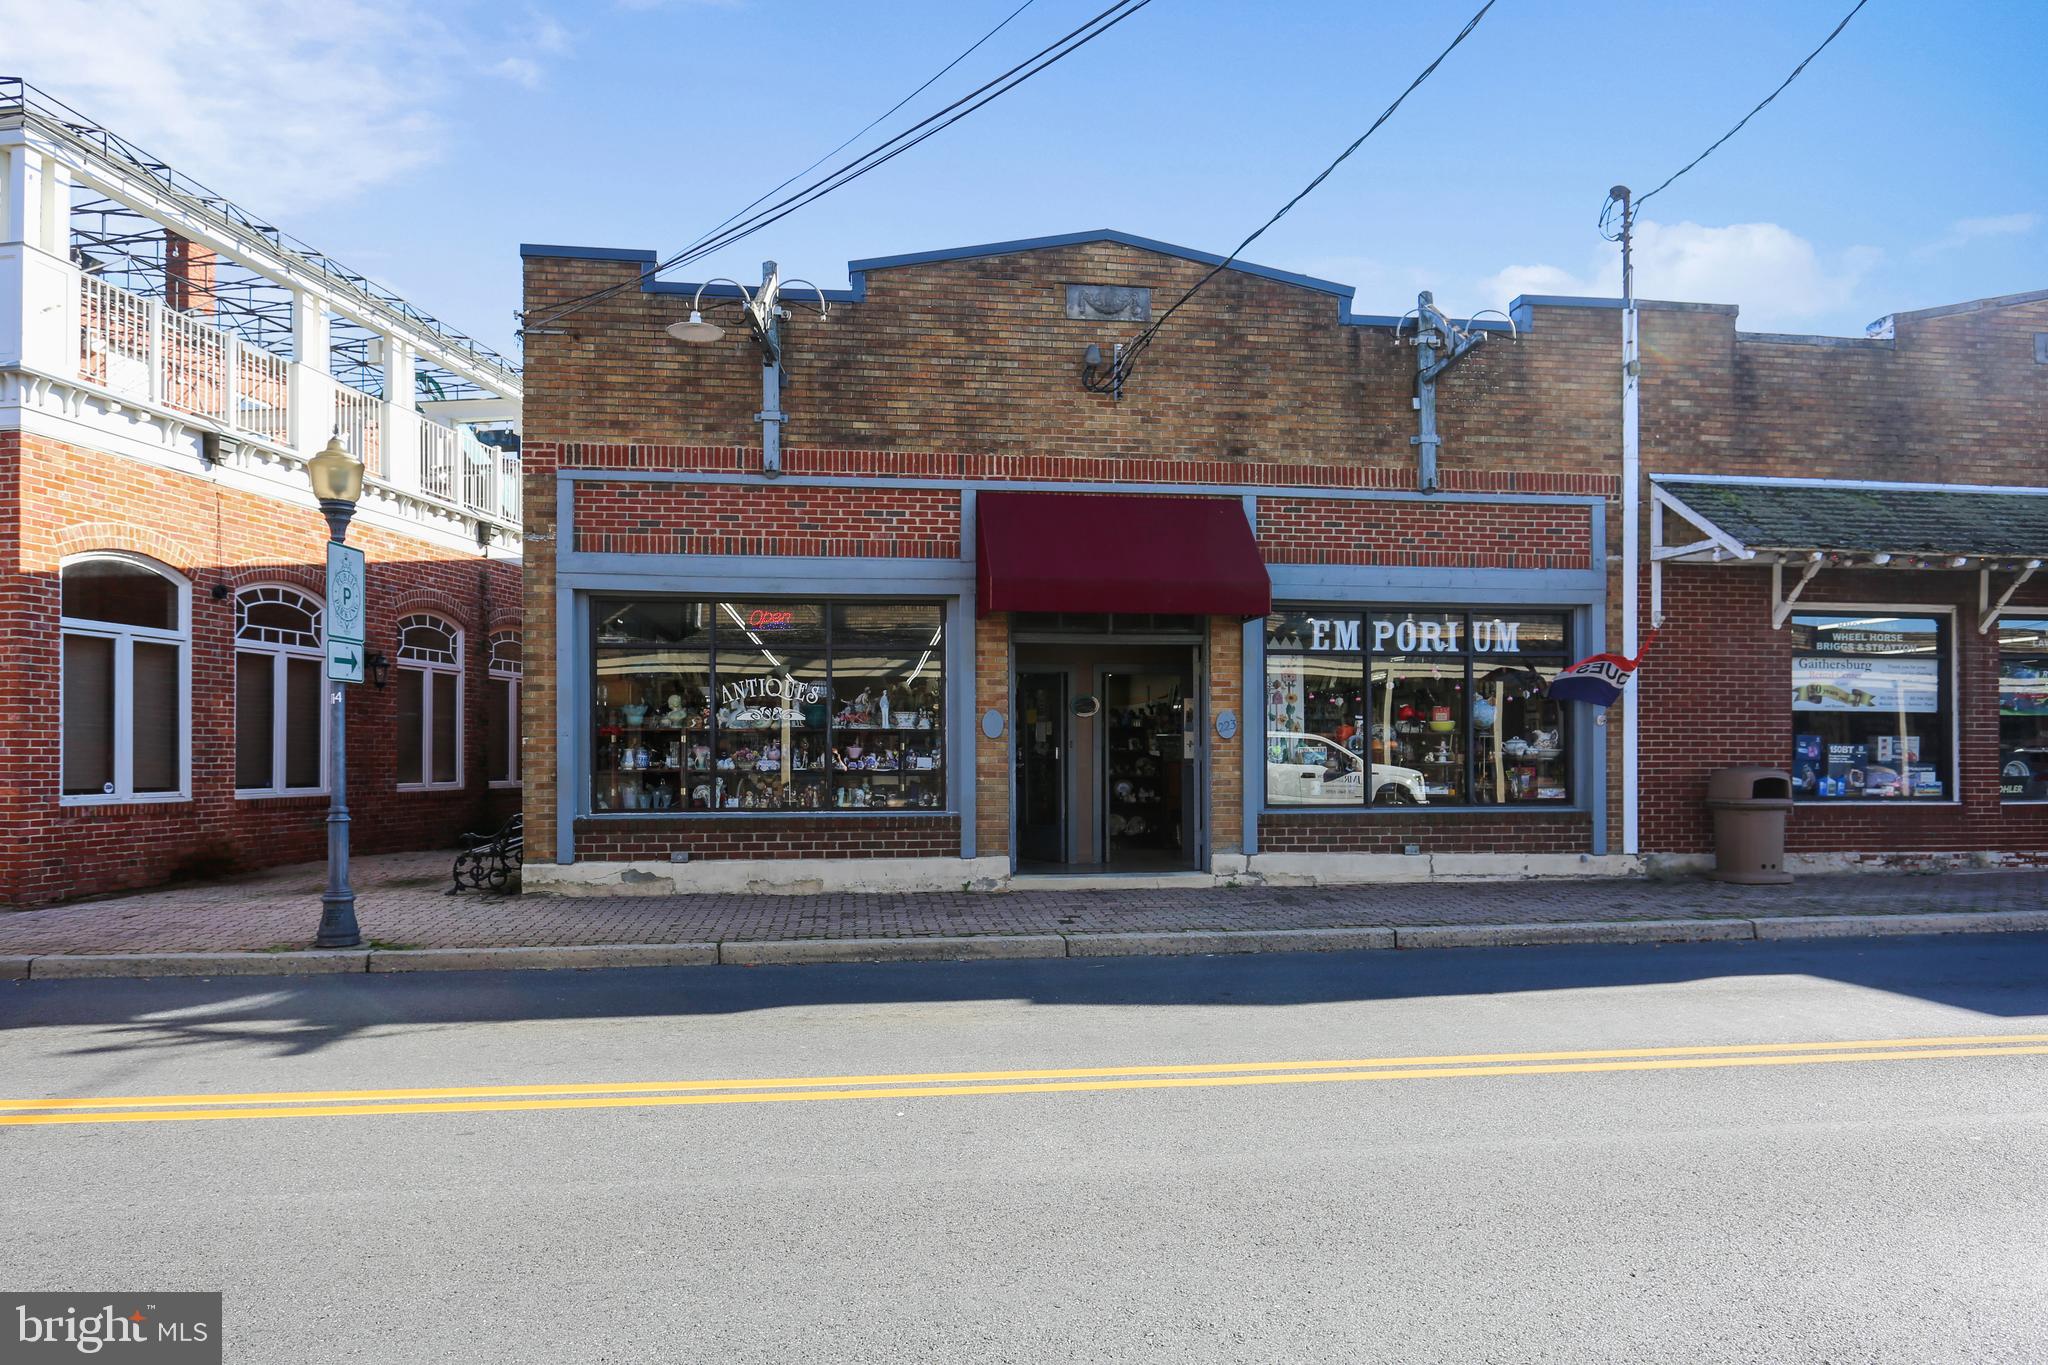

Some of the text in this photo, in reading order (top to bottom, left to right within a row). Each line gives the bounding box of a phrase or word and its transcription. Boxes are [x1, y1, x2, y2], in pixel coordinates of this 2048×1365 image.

[343, 587, 352, 605] P
[334, 599, 358, 618] PARKING
[749, 609, 794, 629] Open
[1832, 633, 1904, 642] WHEEL HORSE
[1816, 642, 1855, 651] BRIGGS
[1798, 658, 1872, 672] Gaithersburg
[721, 678, 820, 704] ANTIQUES
[1218, 719, 1236, 733] 223
